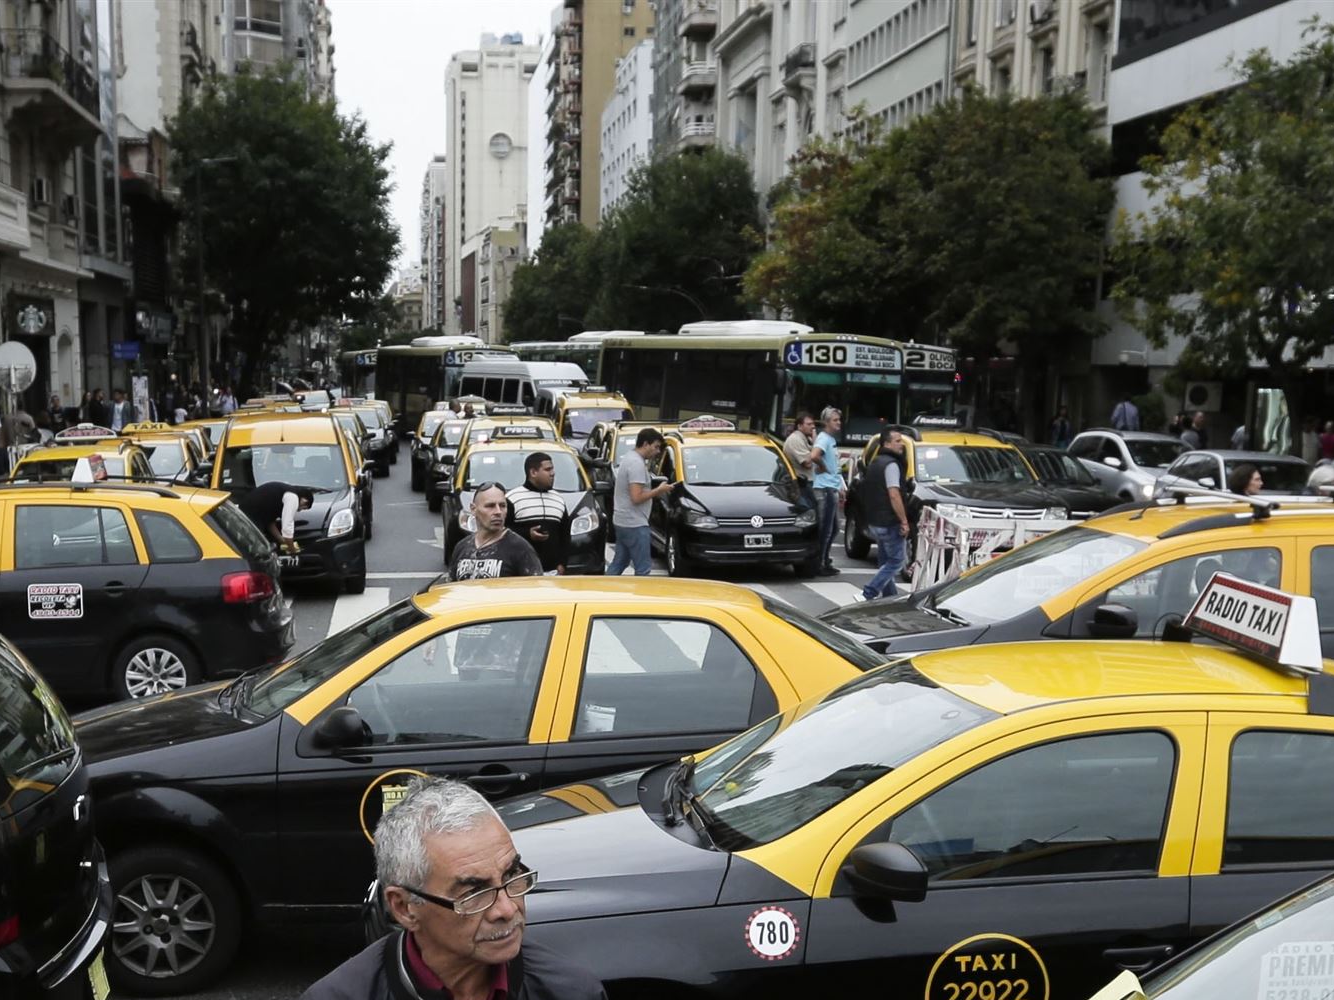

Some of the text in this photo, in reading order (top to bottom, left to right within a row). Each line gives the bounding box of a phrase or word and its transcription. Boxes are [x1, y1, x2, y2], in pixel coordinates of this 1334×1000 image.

[805, 344, 847, 364] 130
[929, 361, 955, 369] BOCA
[31, 586, 79, 594] RADIO TAXI
[1205, 591, 1283, 636] RADIO TAXI
[756, 921, 789, 945] 780
[1271, 944, 1323, 954] ADIO
[955, 953, 1016, 972] TAXI
